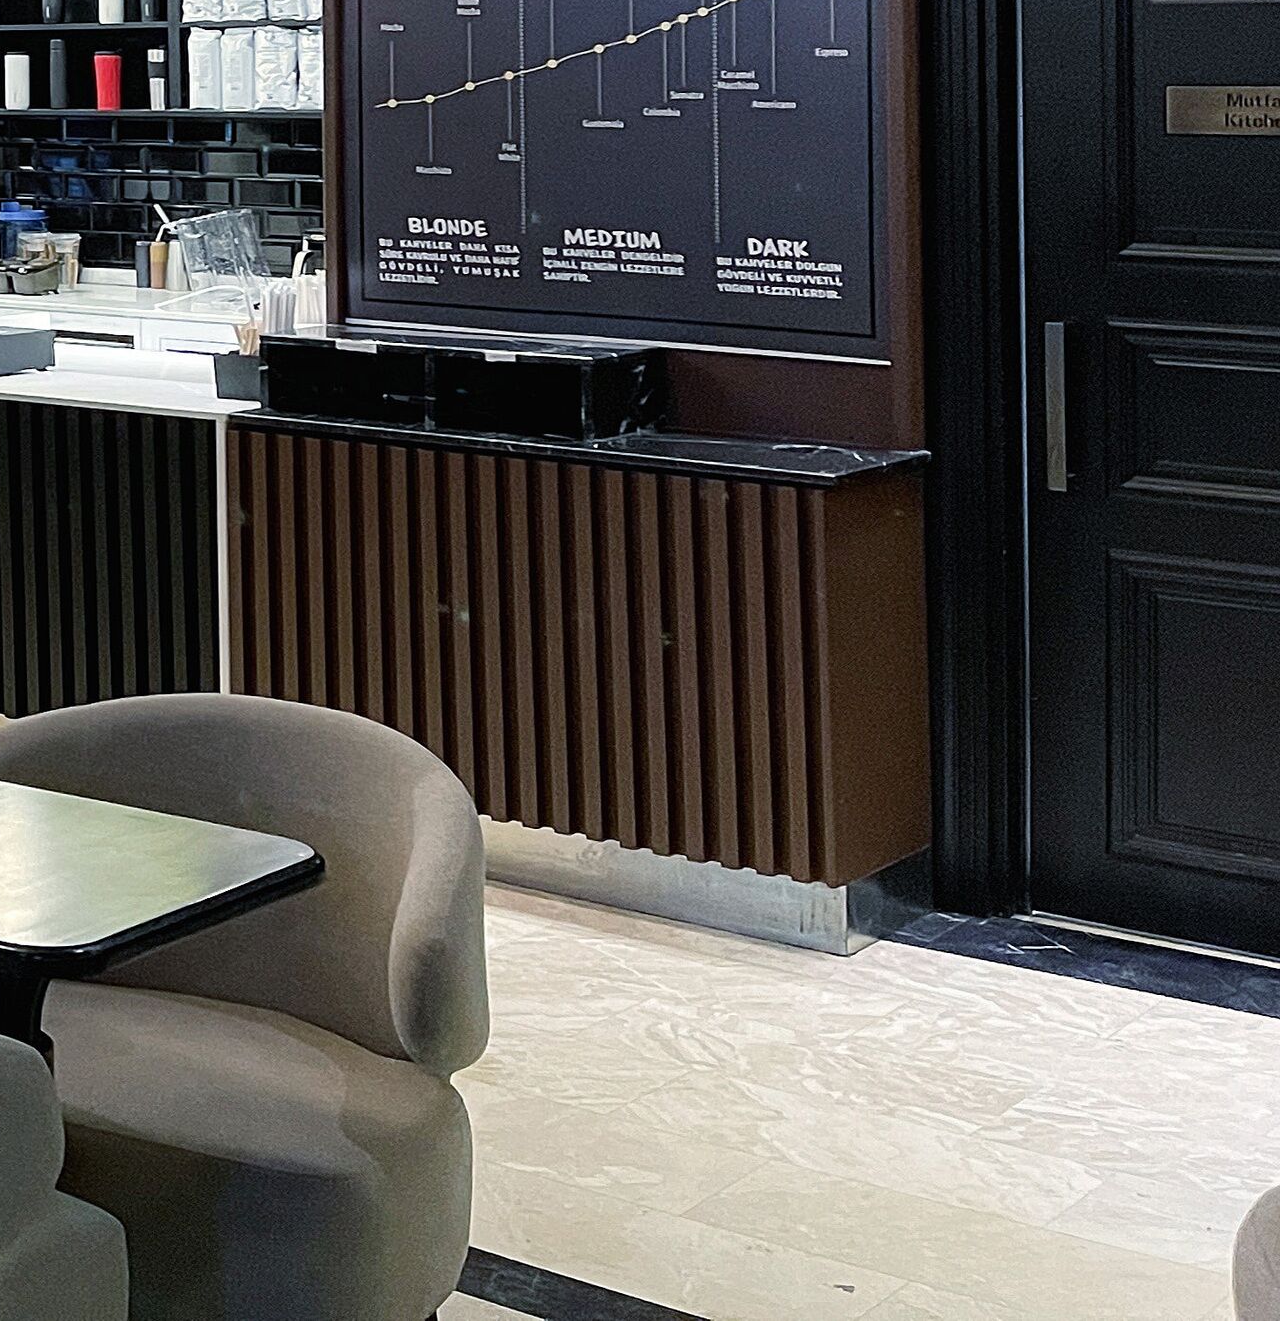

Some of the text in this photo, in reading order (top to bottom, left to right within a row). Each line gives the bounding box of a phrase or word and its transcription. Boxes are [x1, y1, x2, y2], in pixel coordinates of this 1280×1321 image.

[407, 217, 488, 237] BLONDE
[563, 228, 661, 249] MEDIUM
[747, 238, 809, 258] DARK
